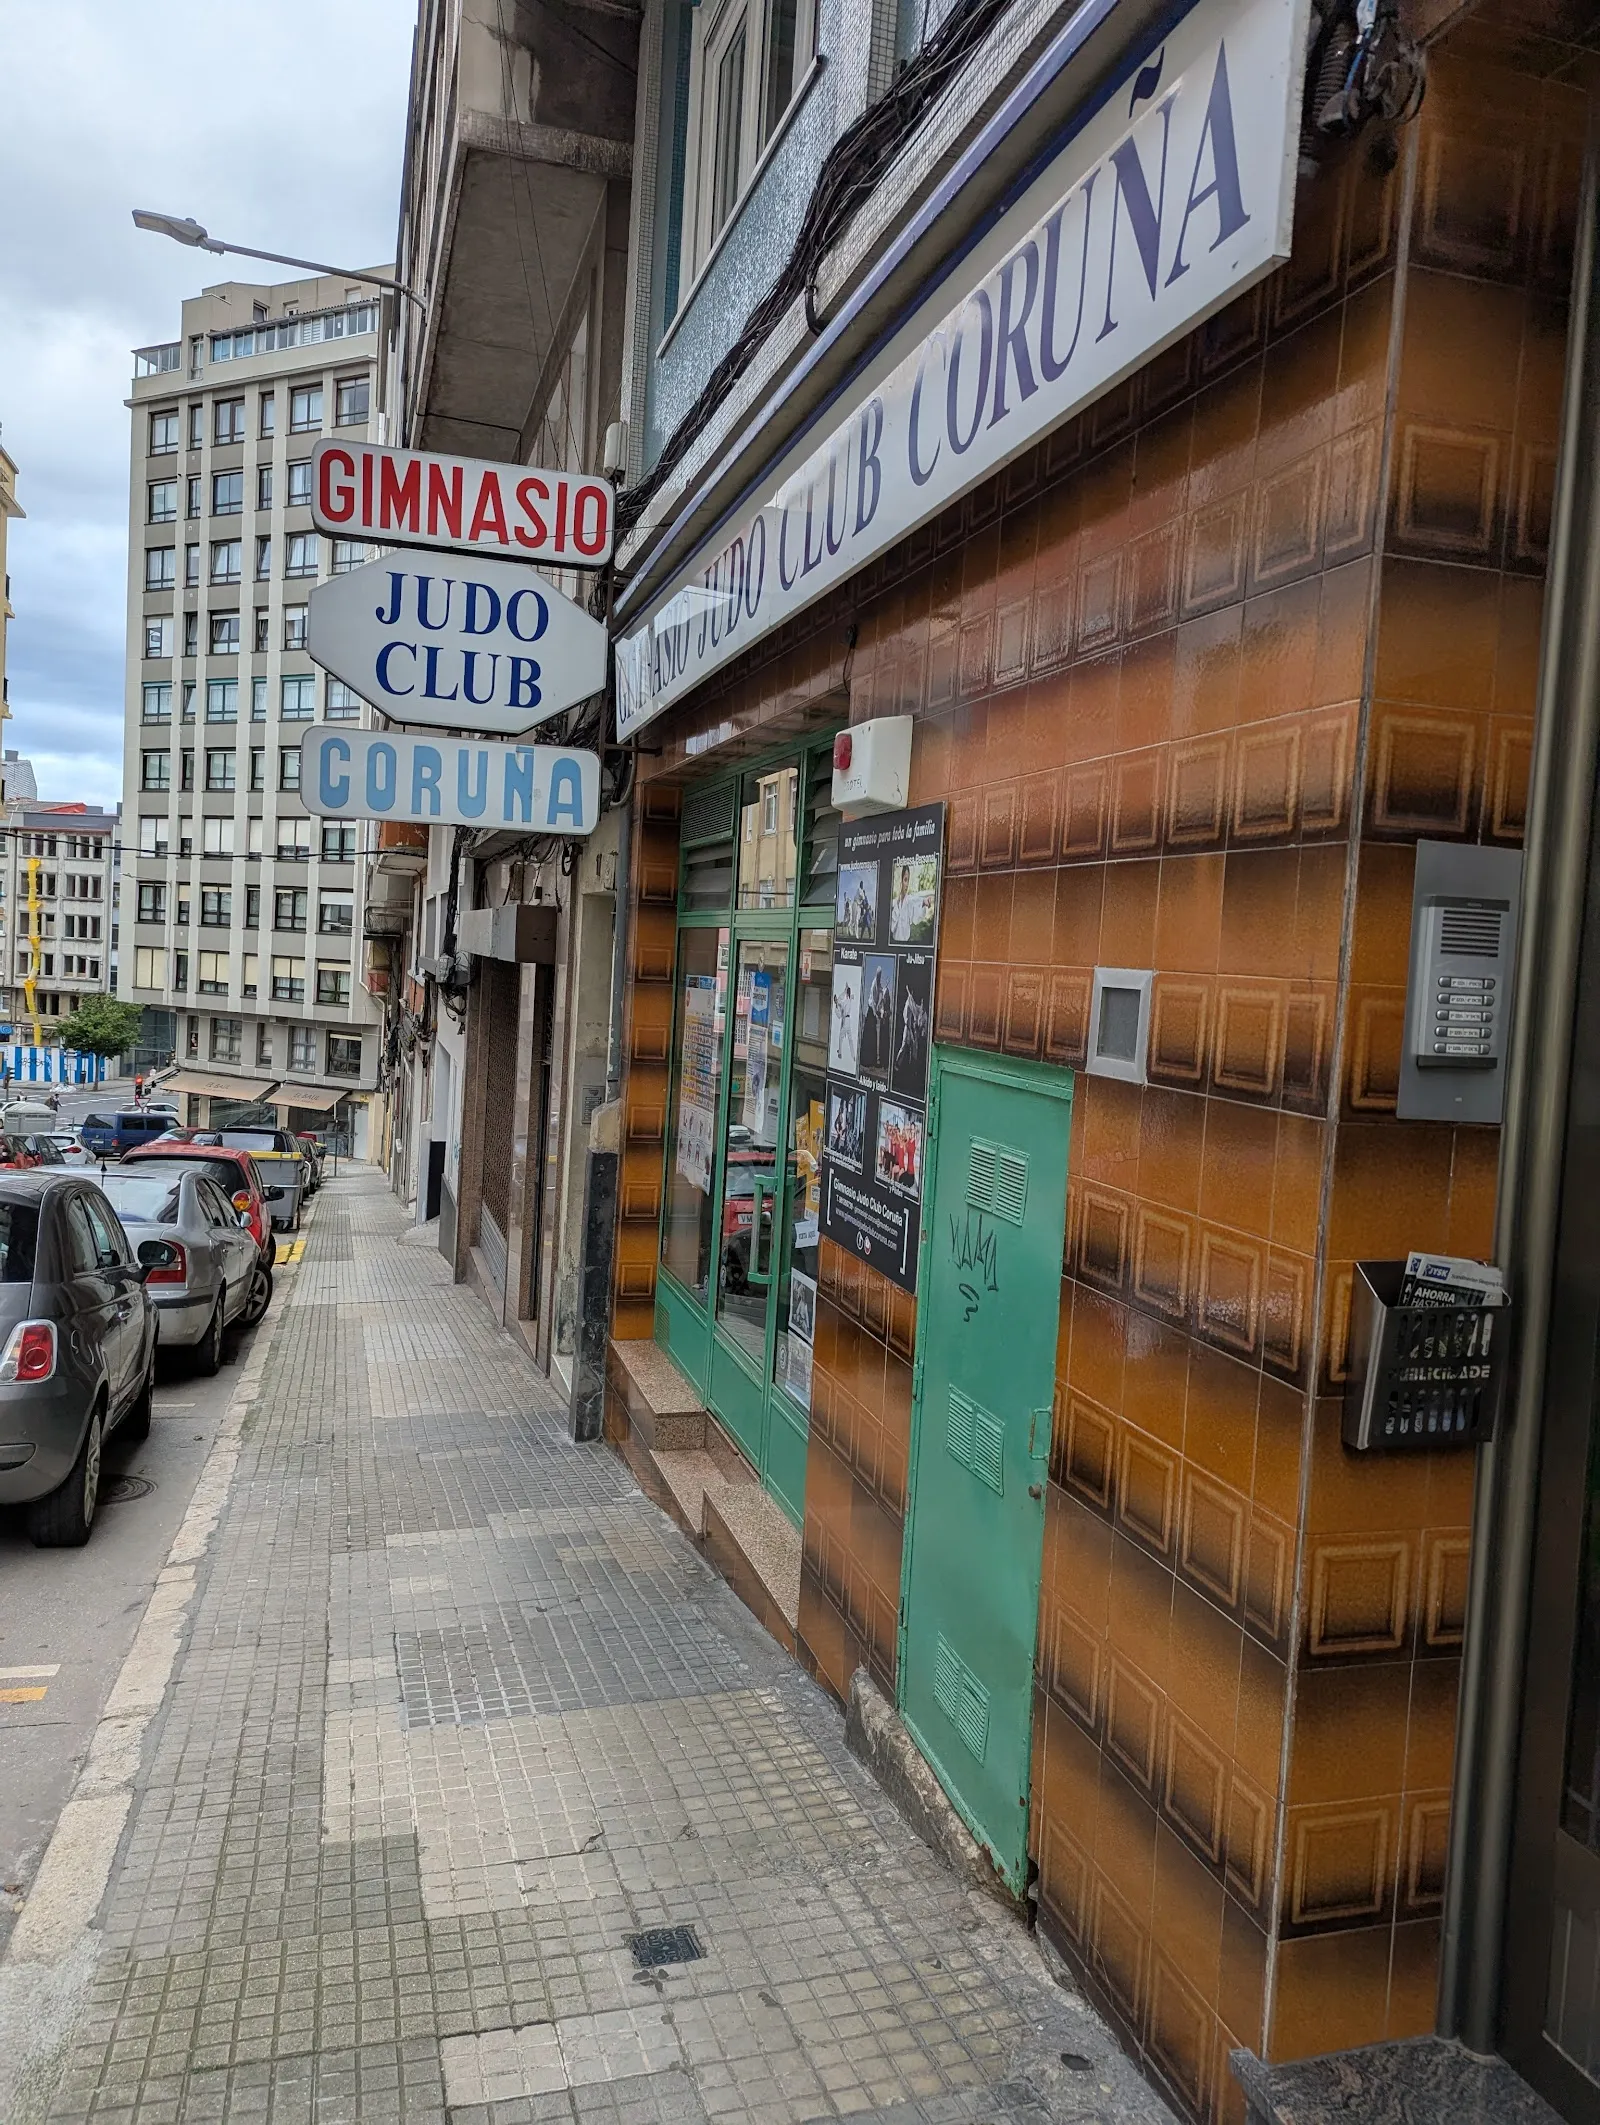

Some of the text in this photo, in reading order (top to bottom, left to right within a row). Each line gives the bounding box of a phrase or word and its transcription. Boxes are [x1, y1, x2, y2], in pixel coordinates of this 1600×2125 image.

[697, 514, 766, 660] JUDO
[780, 397, 886, 592] CLUB
[908, 38, 1252, 487] CORUÑA
[319, 449, 608, 556] GIMNASIO
[375, 571, 549, 642] JUDO
[375, 641, 542, 709] CLUB
[319, 737, 584, 827] CORUÑA
[852, 831, 877, 851] gimnasio
[877, 831, 891, 848] para
[912, 819, 935, 843] familia
[896, 851, 936, 867] Defensa Personal
[840, 948, 858, 960] Karate
[833, 1177, 857, 1200] Gimnasio
[856, 1190, 870, 1207] Judo
[869, 1197, 882, 1214] Club
[882, 1202, 903, 1227] Coruña
[1414, 1287, 1456, 1304] AHORRA
[1428, 1265, 1449, 1278] JYSK
